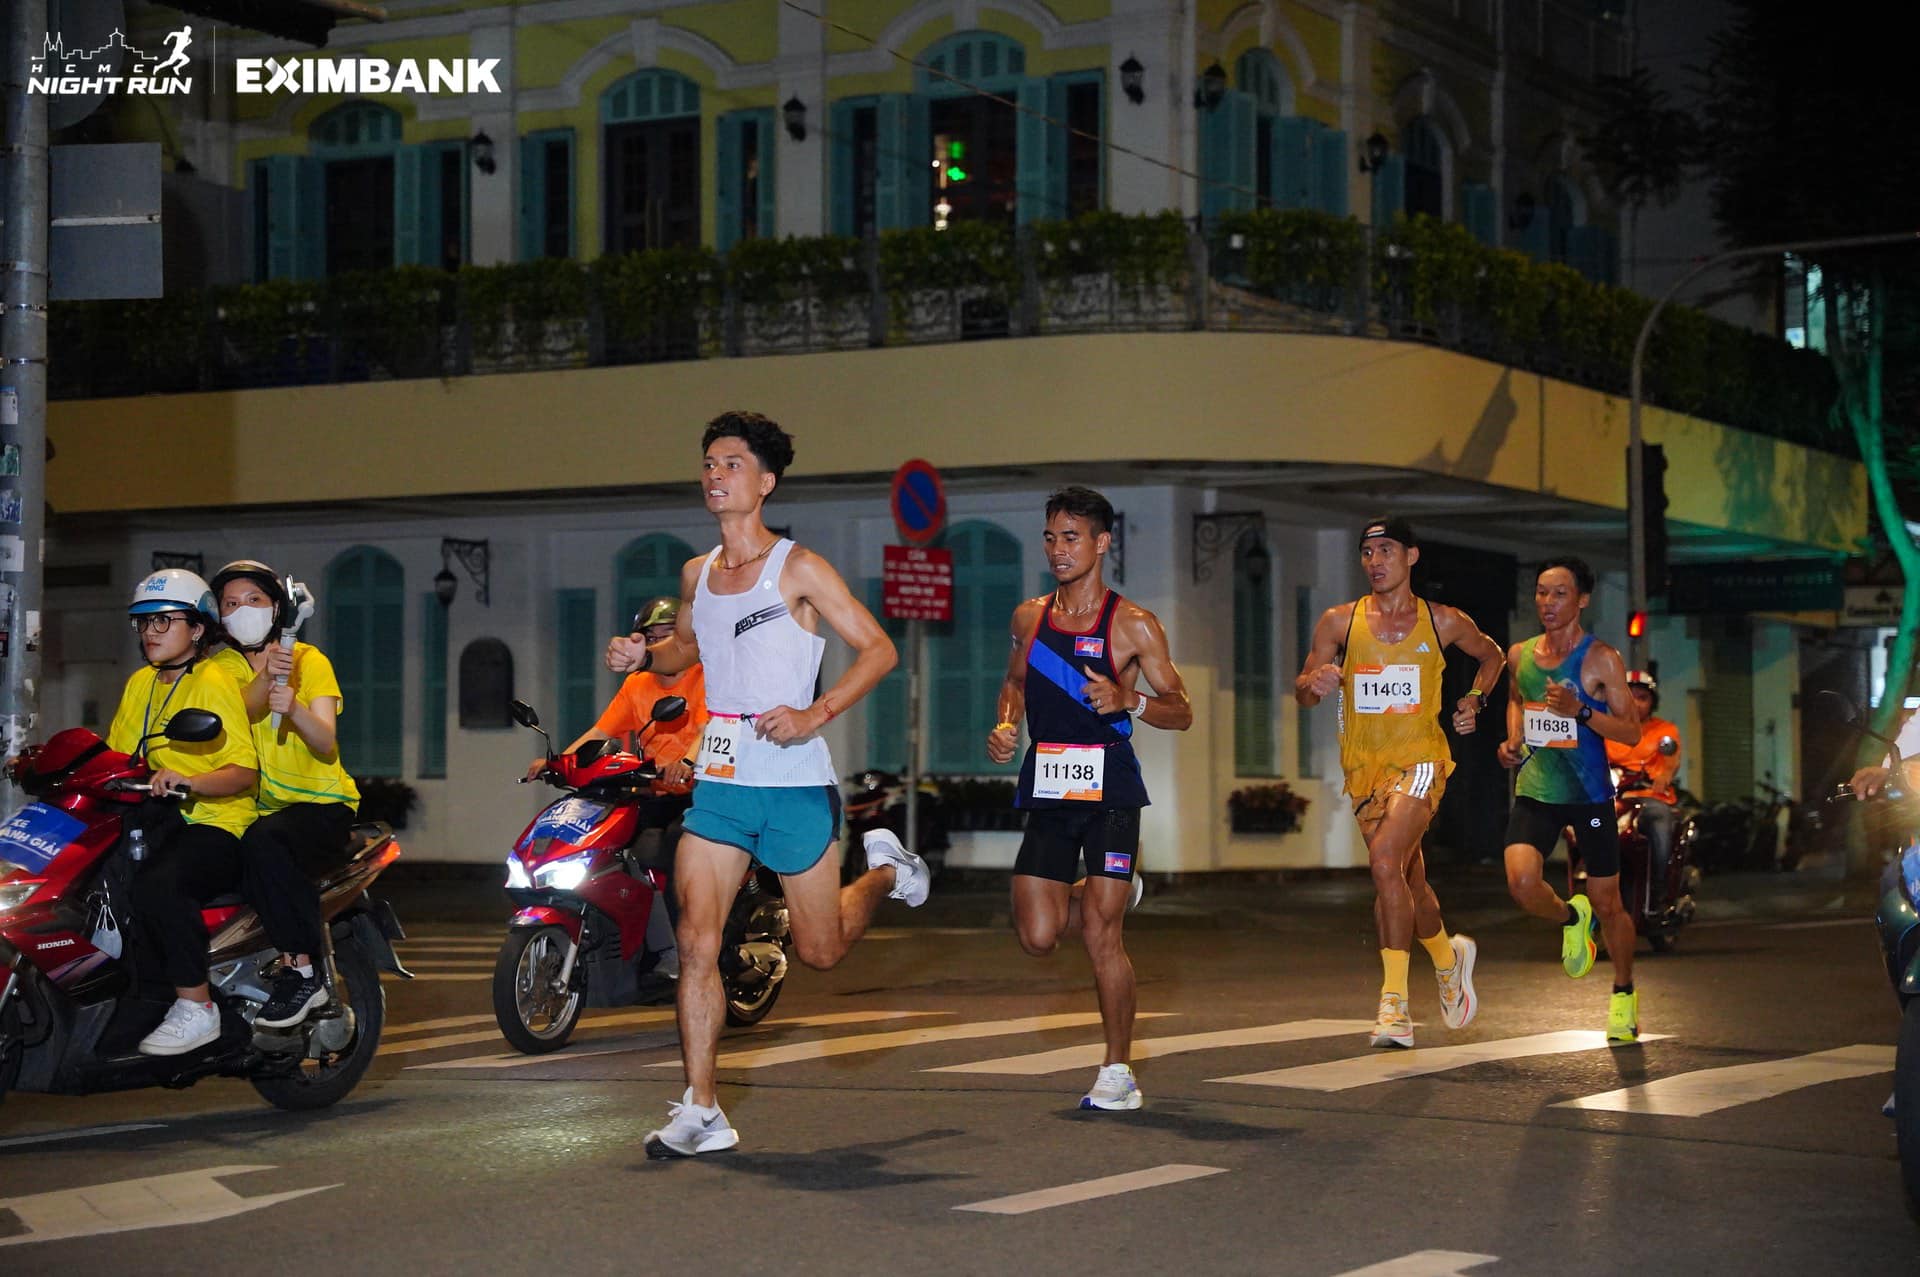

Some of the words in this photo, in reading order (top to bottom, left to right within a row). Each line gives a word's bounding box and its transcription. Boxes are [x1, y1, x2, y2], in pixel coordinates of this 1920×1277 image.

[1362, 682, 1412, 696] 11403
[1529, 717, 1569, 733] 11638
[1043, 762, 1094, 780] 11138
[37, 939, 76, 951] HONDA
